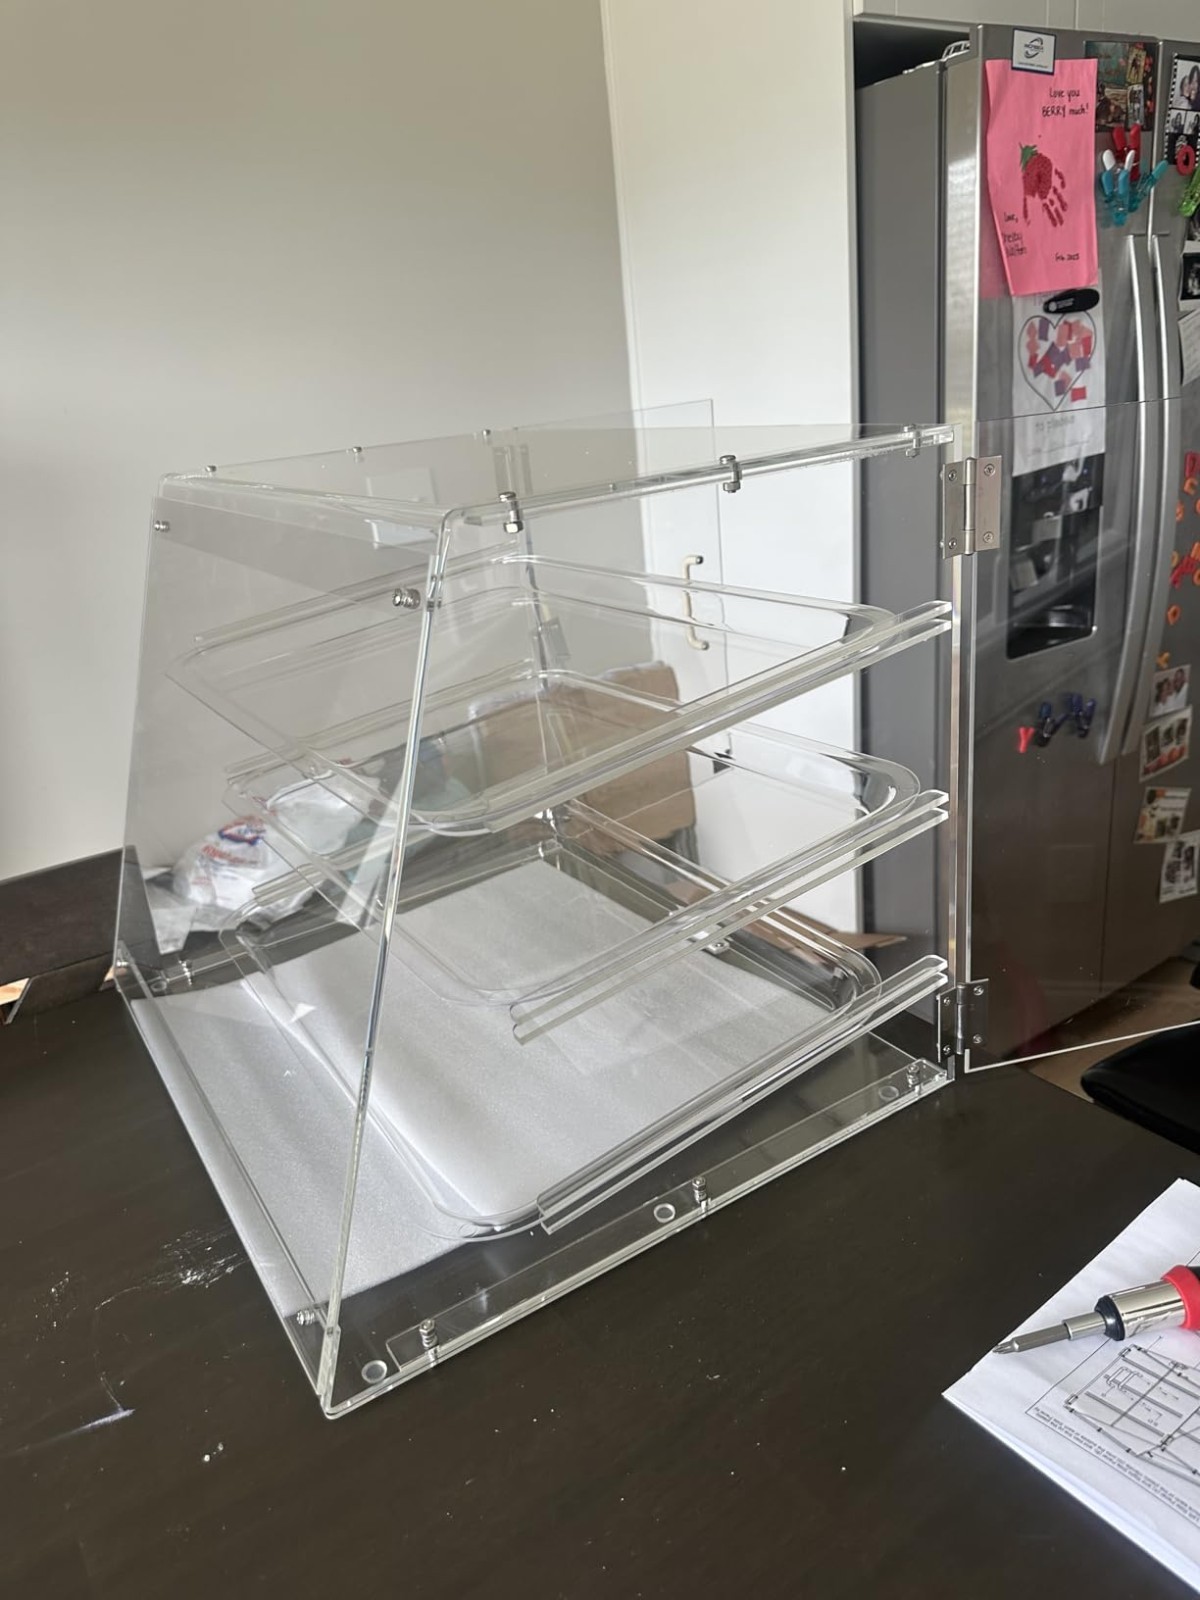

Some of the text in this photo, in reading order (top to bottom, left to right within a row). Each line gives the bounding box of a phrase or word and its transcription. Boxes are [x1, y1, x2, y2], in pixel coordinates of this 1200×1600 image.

[1049, 87, 1080, 102] Love you
[1042, 105, 1066, 118] BERRY
